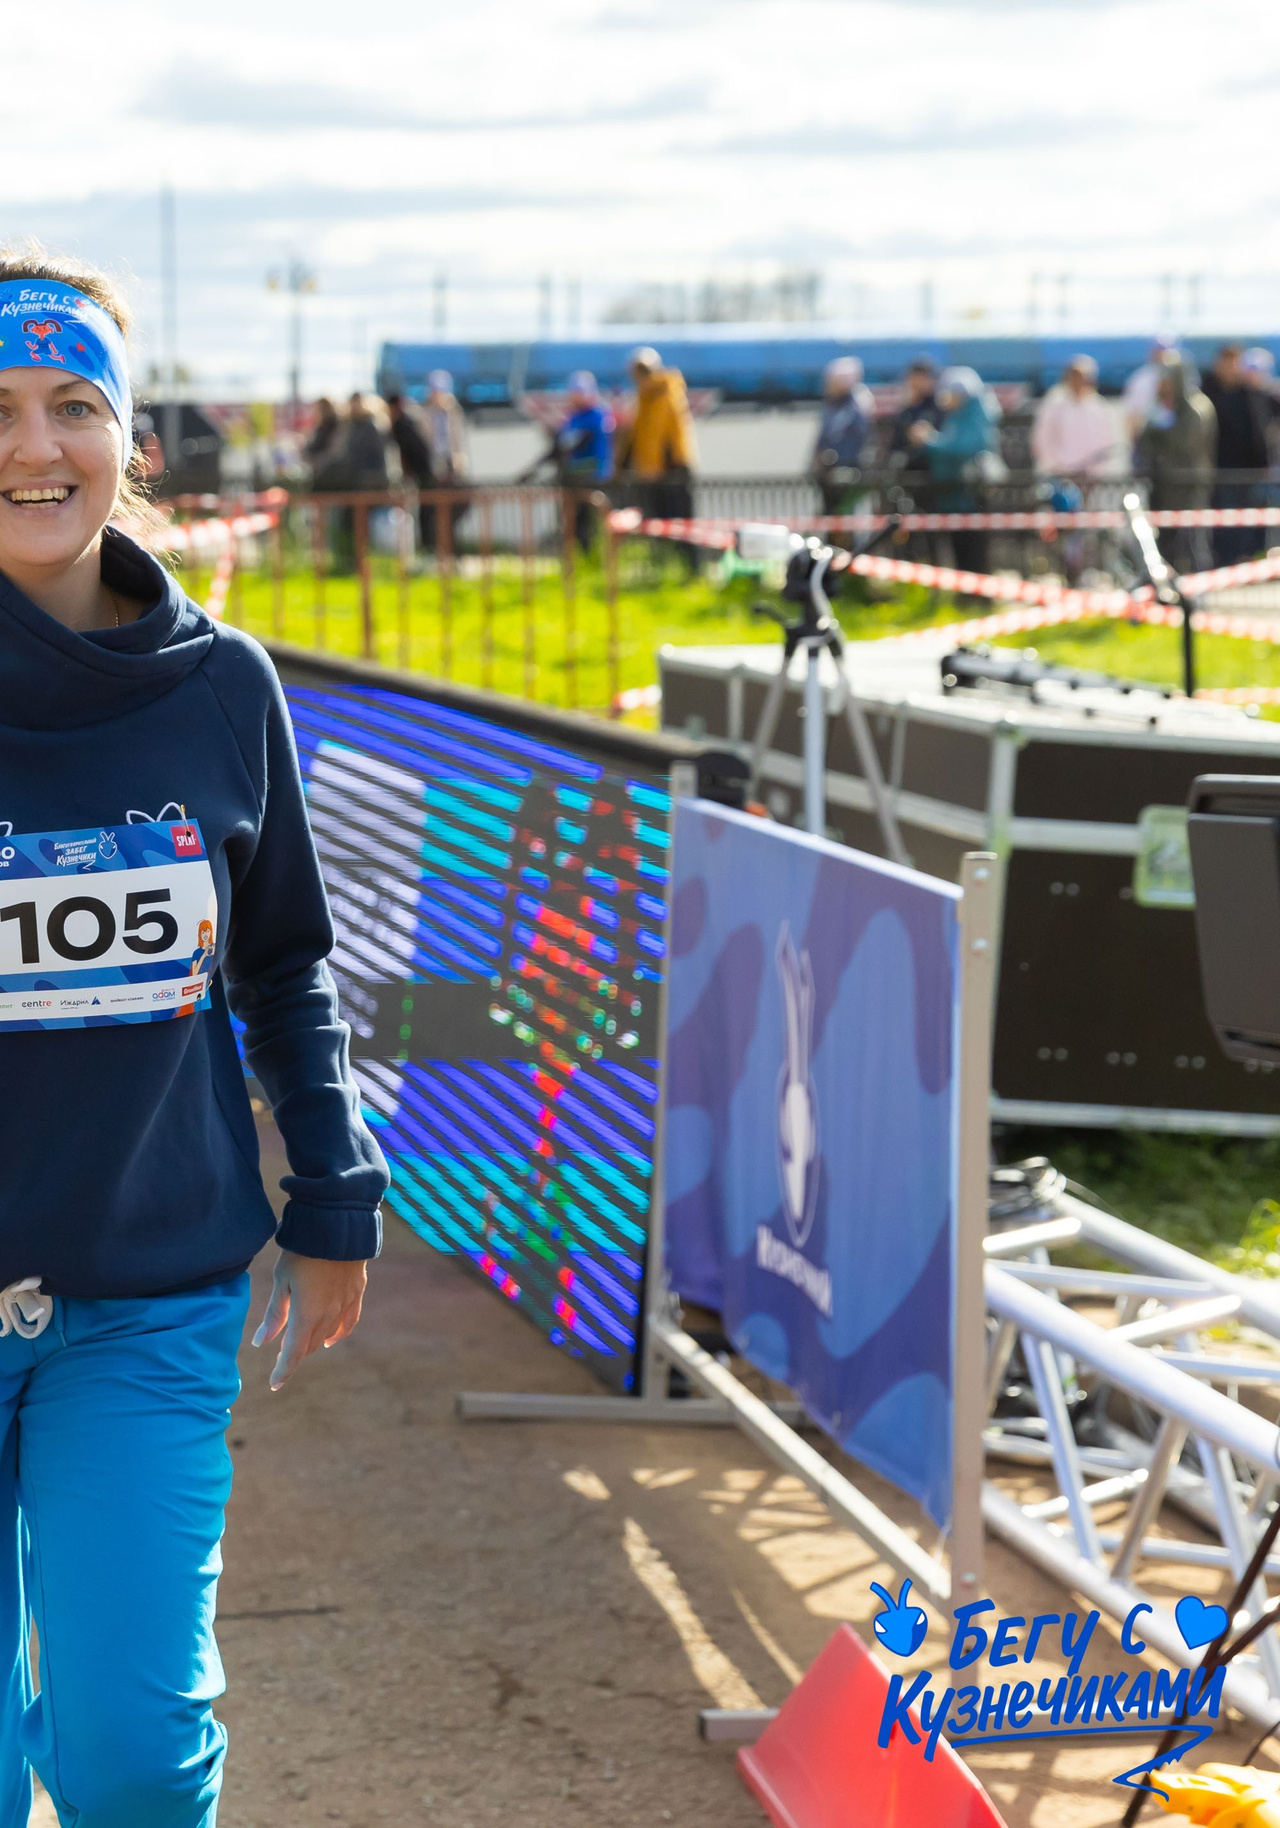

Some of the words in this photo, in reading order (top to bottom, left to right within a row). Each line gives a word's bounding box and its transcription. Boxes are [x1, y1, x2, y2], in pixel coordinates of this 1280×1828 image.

[176, 834, 196, 847] SPLAT
[65, 845, 87, 856] ЗАБЕГ
[56, 852, 97, 868] Кузнечики
[0, 888, 179, 965] 105
[21, 1000, 52, 1008] centre
